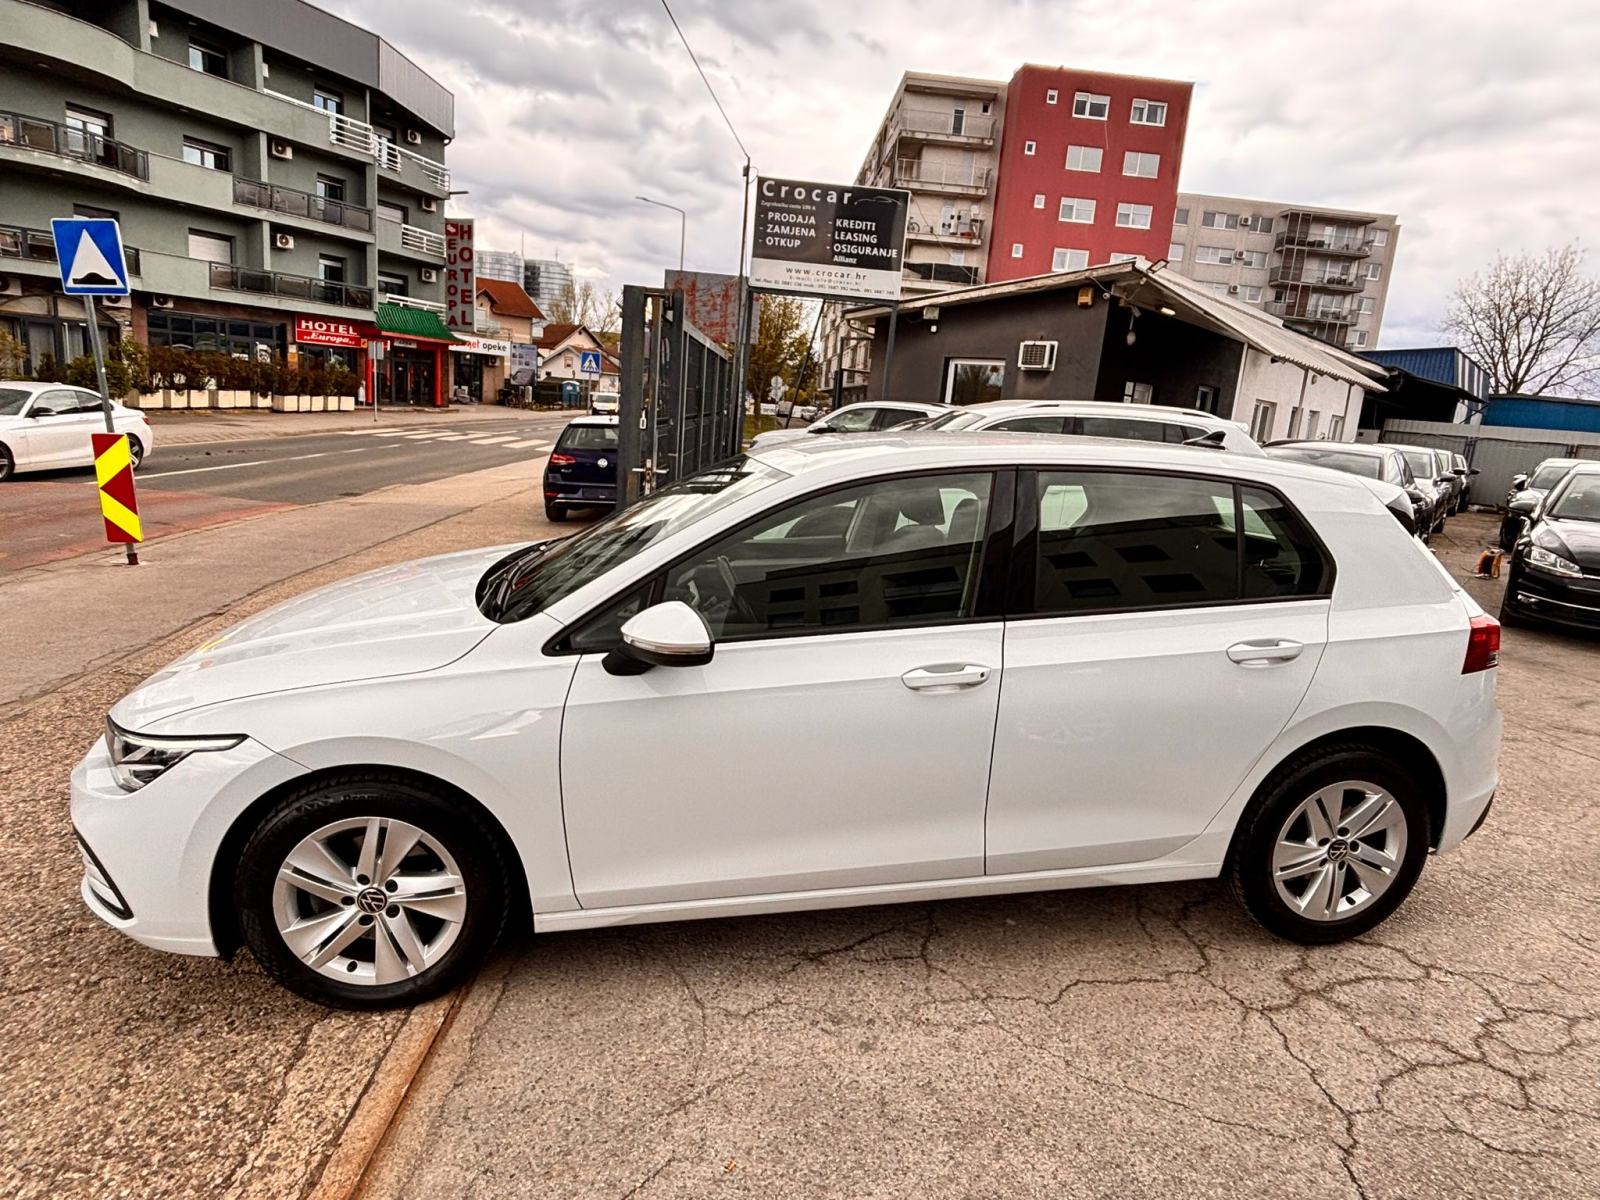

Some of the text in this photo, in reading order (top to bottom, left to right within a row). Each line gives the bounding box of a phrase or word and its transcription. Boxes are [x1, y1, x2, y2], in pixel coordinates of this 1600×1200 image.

[762, 180, 852, 205] Crocar
[767, 211, 816, 225] PRODAJA
[835, 218, 876, 232] KREDITI
[766, 224, 816, 237] ZAMJENA
[834, 231, 878, 244] LEASING
[765, 236, 801, 248] OTKUP
[833, 243, 898, 258] OSIGURANJE
[833, 254, 857, 265] Allianz
[447, 238, 458, 326] EUROPA
[459, 224, 473, 326] HOTEL
[301, 319, 358, 336] HOTEL
[482, 342, 508, 353] opeke
